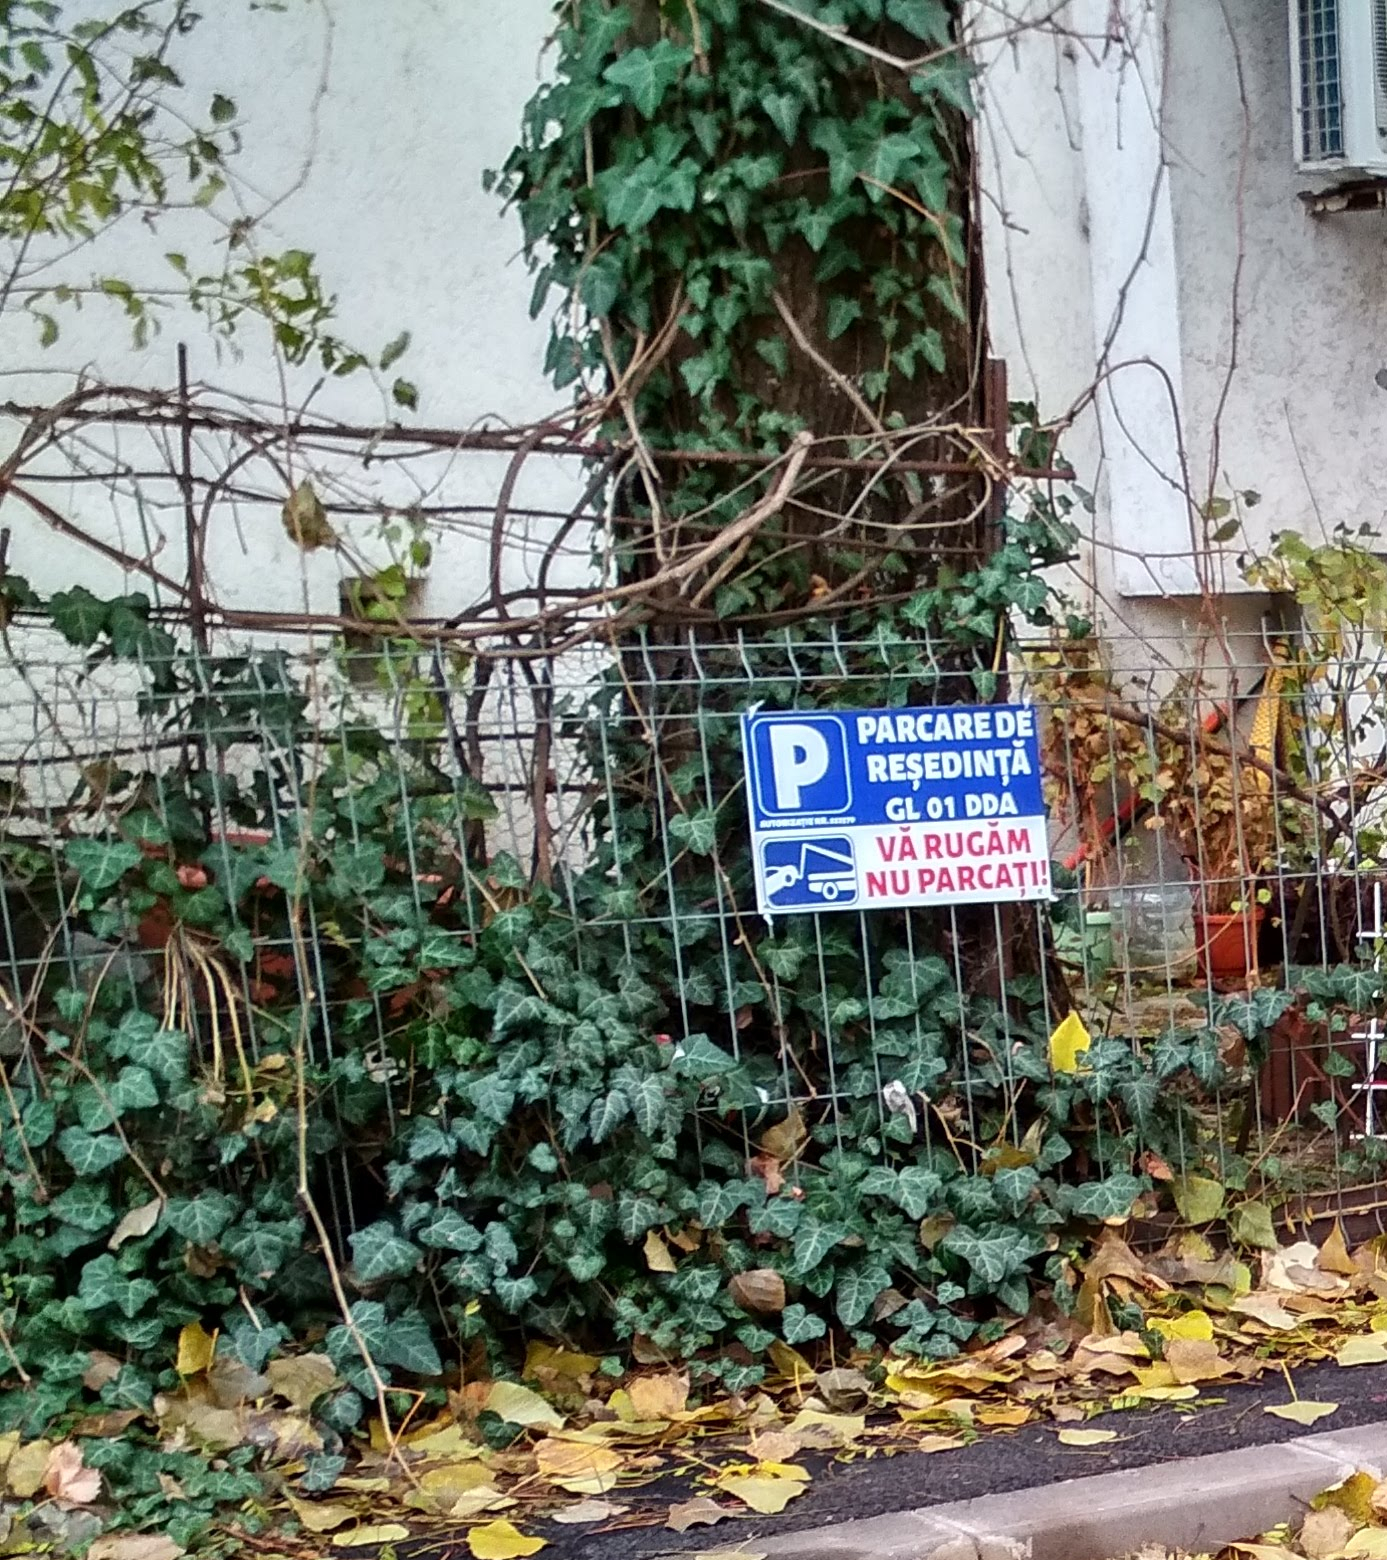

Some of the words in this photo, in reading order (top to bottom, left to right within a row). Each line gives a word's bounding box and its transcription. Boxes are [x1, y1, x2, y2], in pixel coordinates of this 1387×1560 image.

[857, 714, 991, 744] PARCARE
[996, 711, 1033, 738] DE
[866, 740, 1031, 790] REȘEDINȚĂ
[886, 799, 920, 821] GL
[927, 796, 955, 819] 01
[965, 793, 1018, 817] DDA
[876, 826, 917, 862] VĂ
[923, 821, 1031, 859] RUGĂM
[865, 868, 910, 897] NU
[918, 860, 1049, 897] PARCAȚI!
